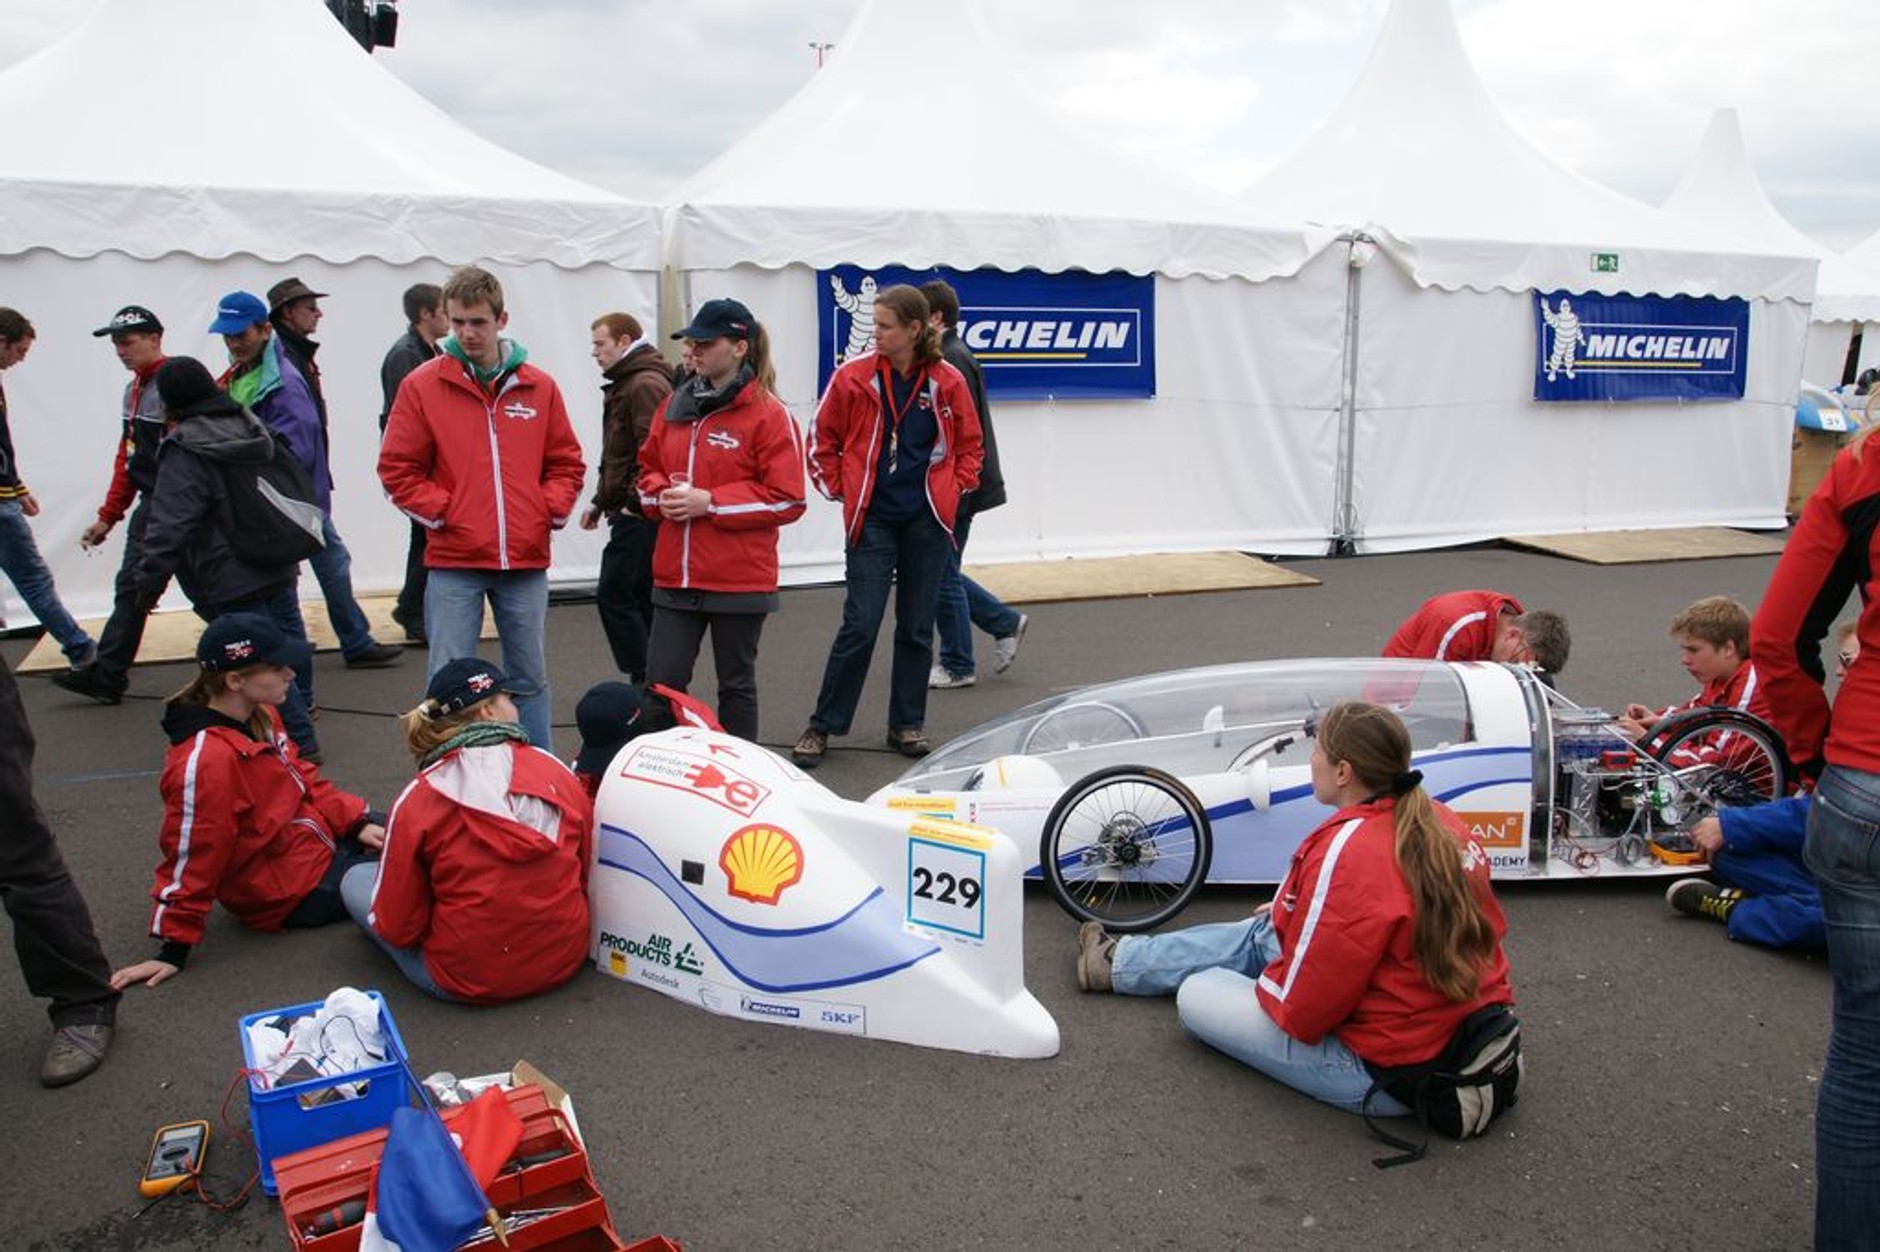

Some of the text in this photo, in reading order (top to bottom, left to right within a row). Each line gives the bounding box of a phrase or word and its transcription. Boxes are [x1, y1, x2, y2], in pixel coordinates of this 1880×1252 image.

[956, 320, 1130, 349] ICHELIN
[1586, 334, 1730, 360] MICHELIN
[913, 867, 981, 909] 229
[600, 931, 672, 967] PRODUCTS
[648, 933, 672, 951] AIR
[641, 969, 680, 988] Autodesk
[751, 1003, 798, 1016] MICHELIN
[822, 1010, 860, 1024] SKF
